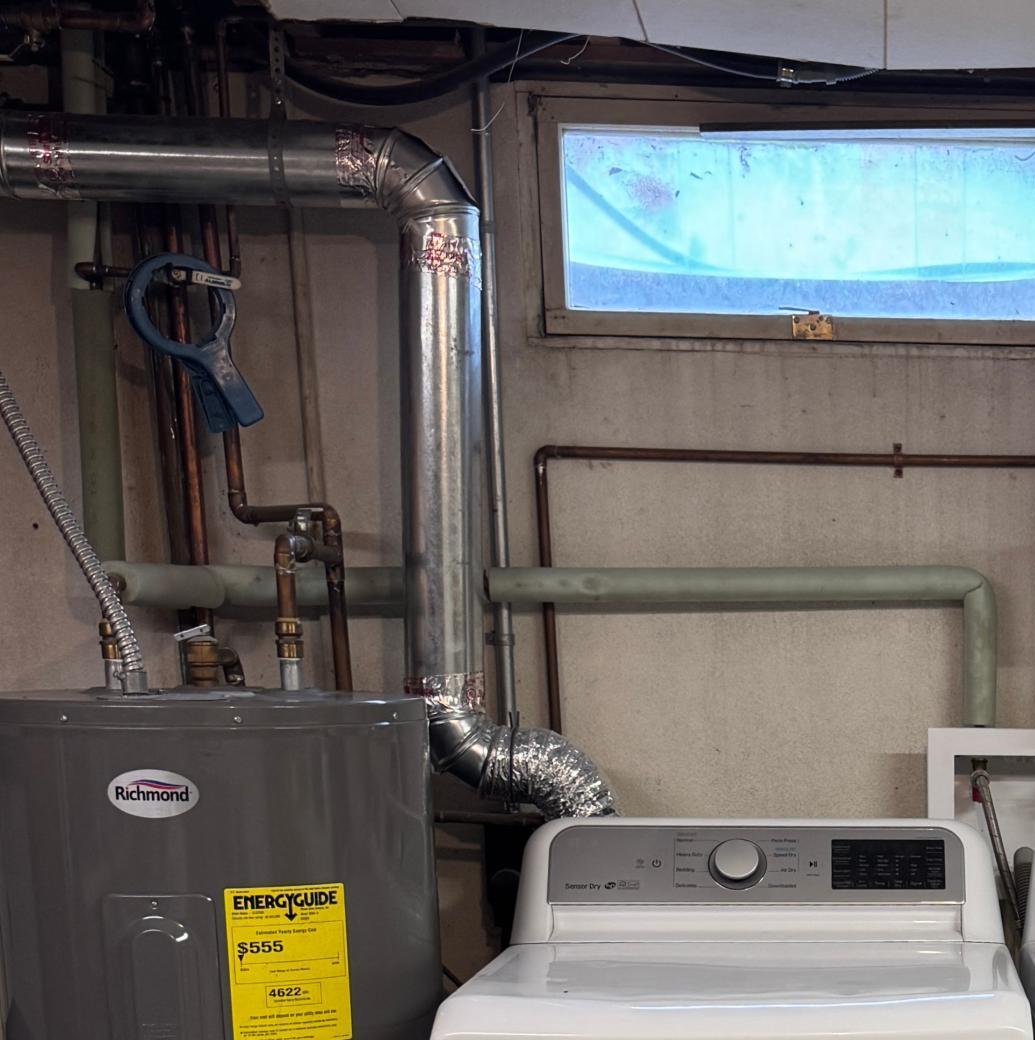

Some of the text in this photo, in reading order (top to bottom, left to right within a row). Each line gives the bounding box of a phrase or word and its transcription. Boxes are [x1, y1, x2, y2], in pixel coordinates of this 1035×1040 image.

[115, 785, 189, 802] Richmond
[589, 883, 601, 891] Dry
[237, 940, 284, 955] $555
[269, 986, 302, 998] 4622
